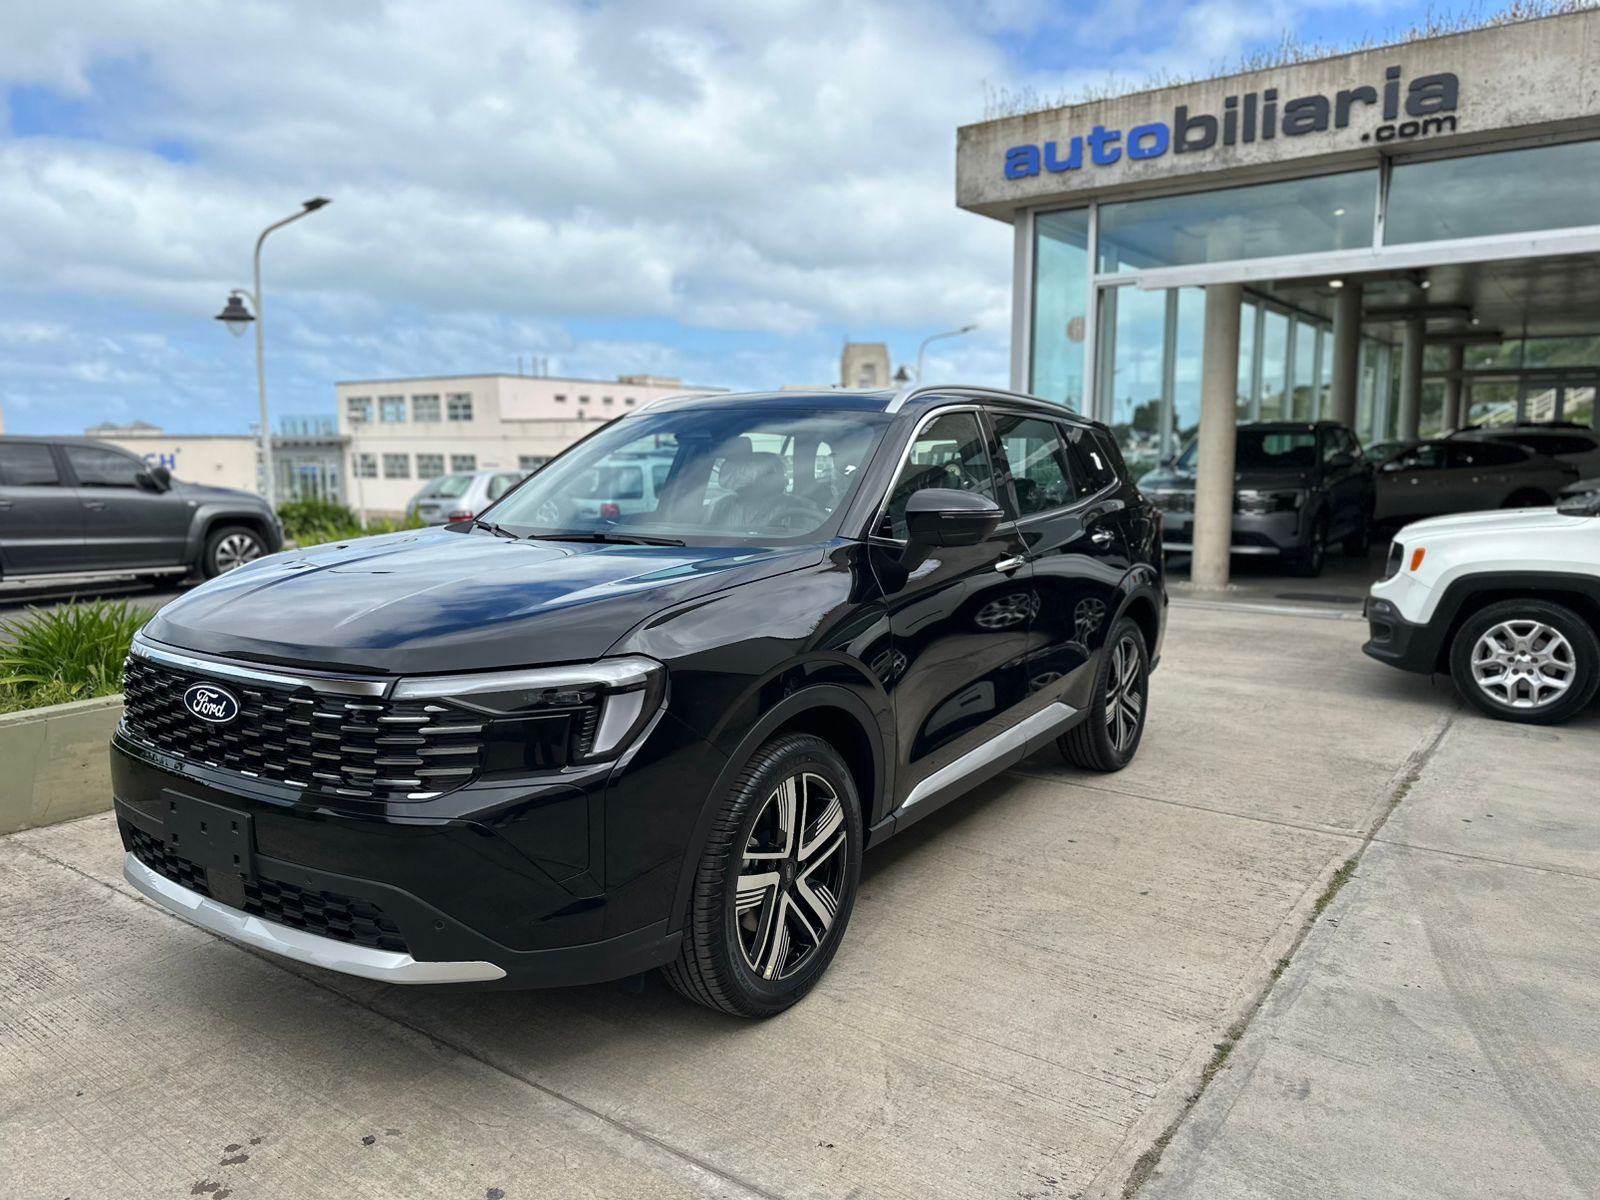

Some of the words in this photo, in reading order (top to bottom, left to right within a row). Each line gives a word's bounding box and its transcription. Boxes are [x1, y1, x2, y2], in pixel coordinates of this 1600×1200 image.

[1003, 65, 1460, 181] autobiliaria
[1360, 115, 1457, 143] .com
[193, 689, 227, 718] Ford
